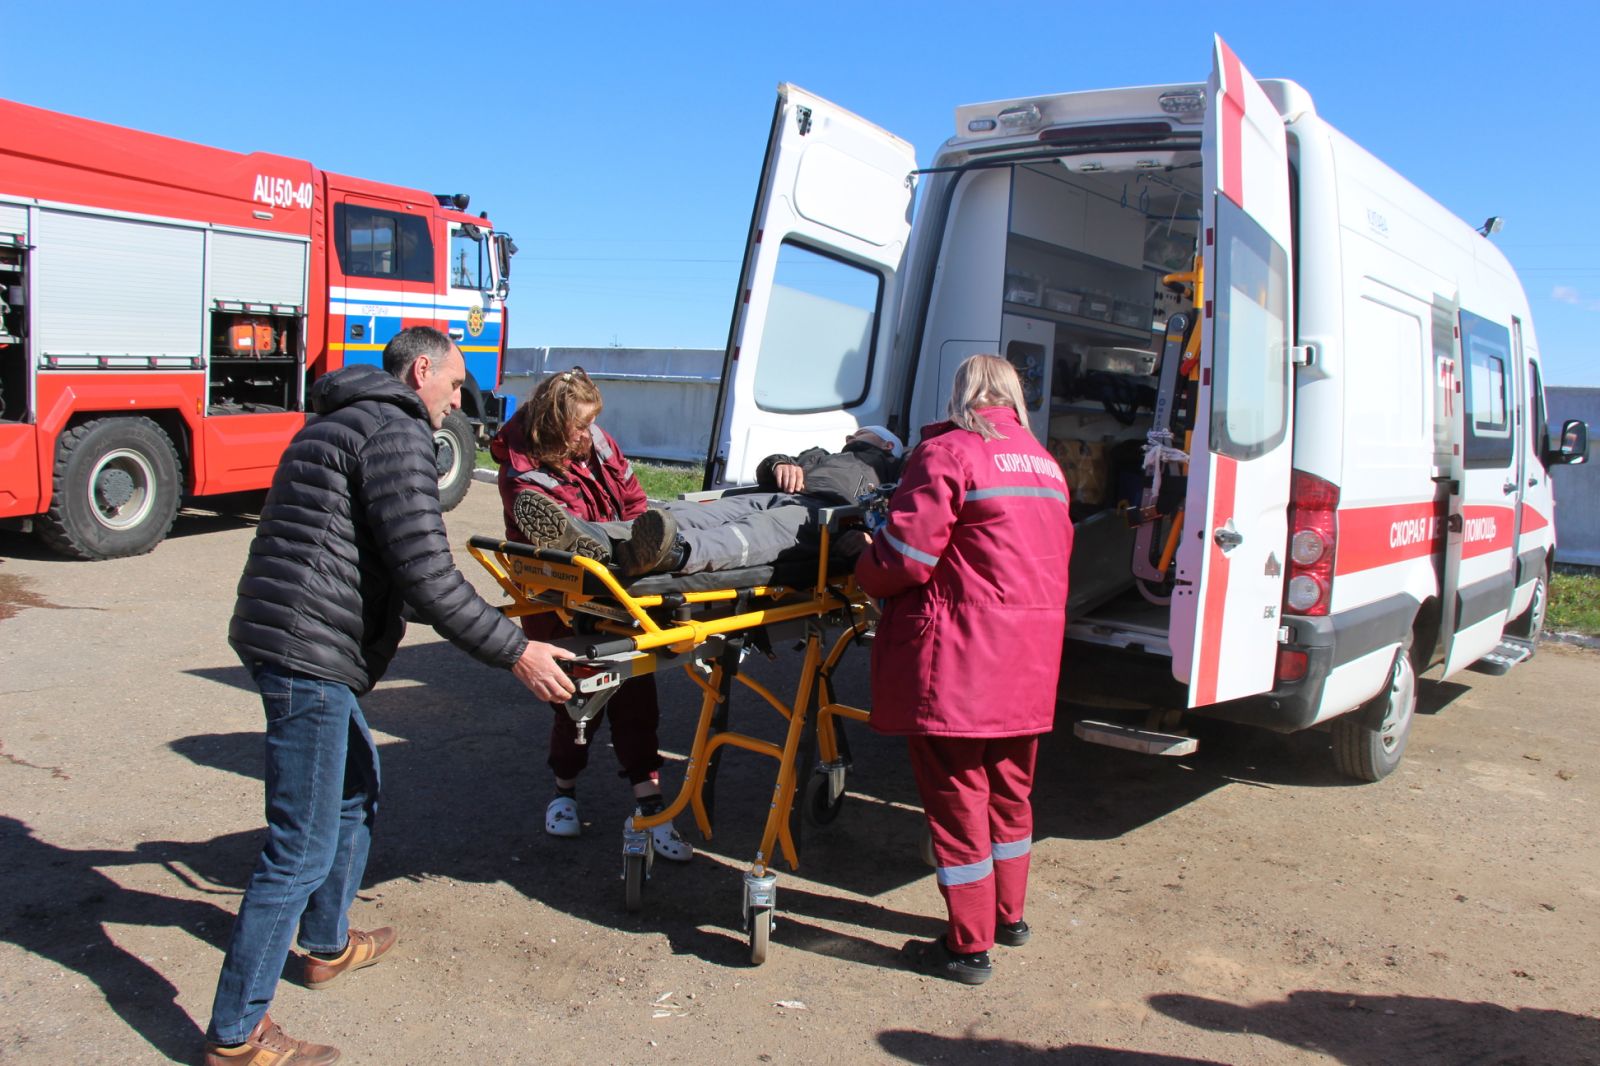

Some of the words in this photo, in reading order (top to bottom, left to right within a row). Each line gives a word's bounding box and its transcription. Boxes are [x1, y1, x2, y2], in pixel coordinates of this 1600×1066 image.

[994, 452, 1033, 473] СКОРАЯ
[1389, 517, 1427, 549] СКОРАЯ
[1463, 516, 1497, 543] ПОМОЩЬ
